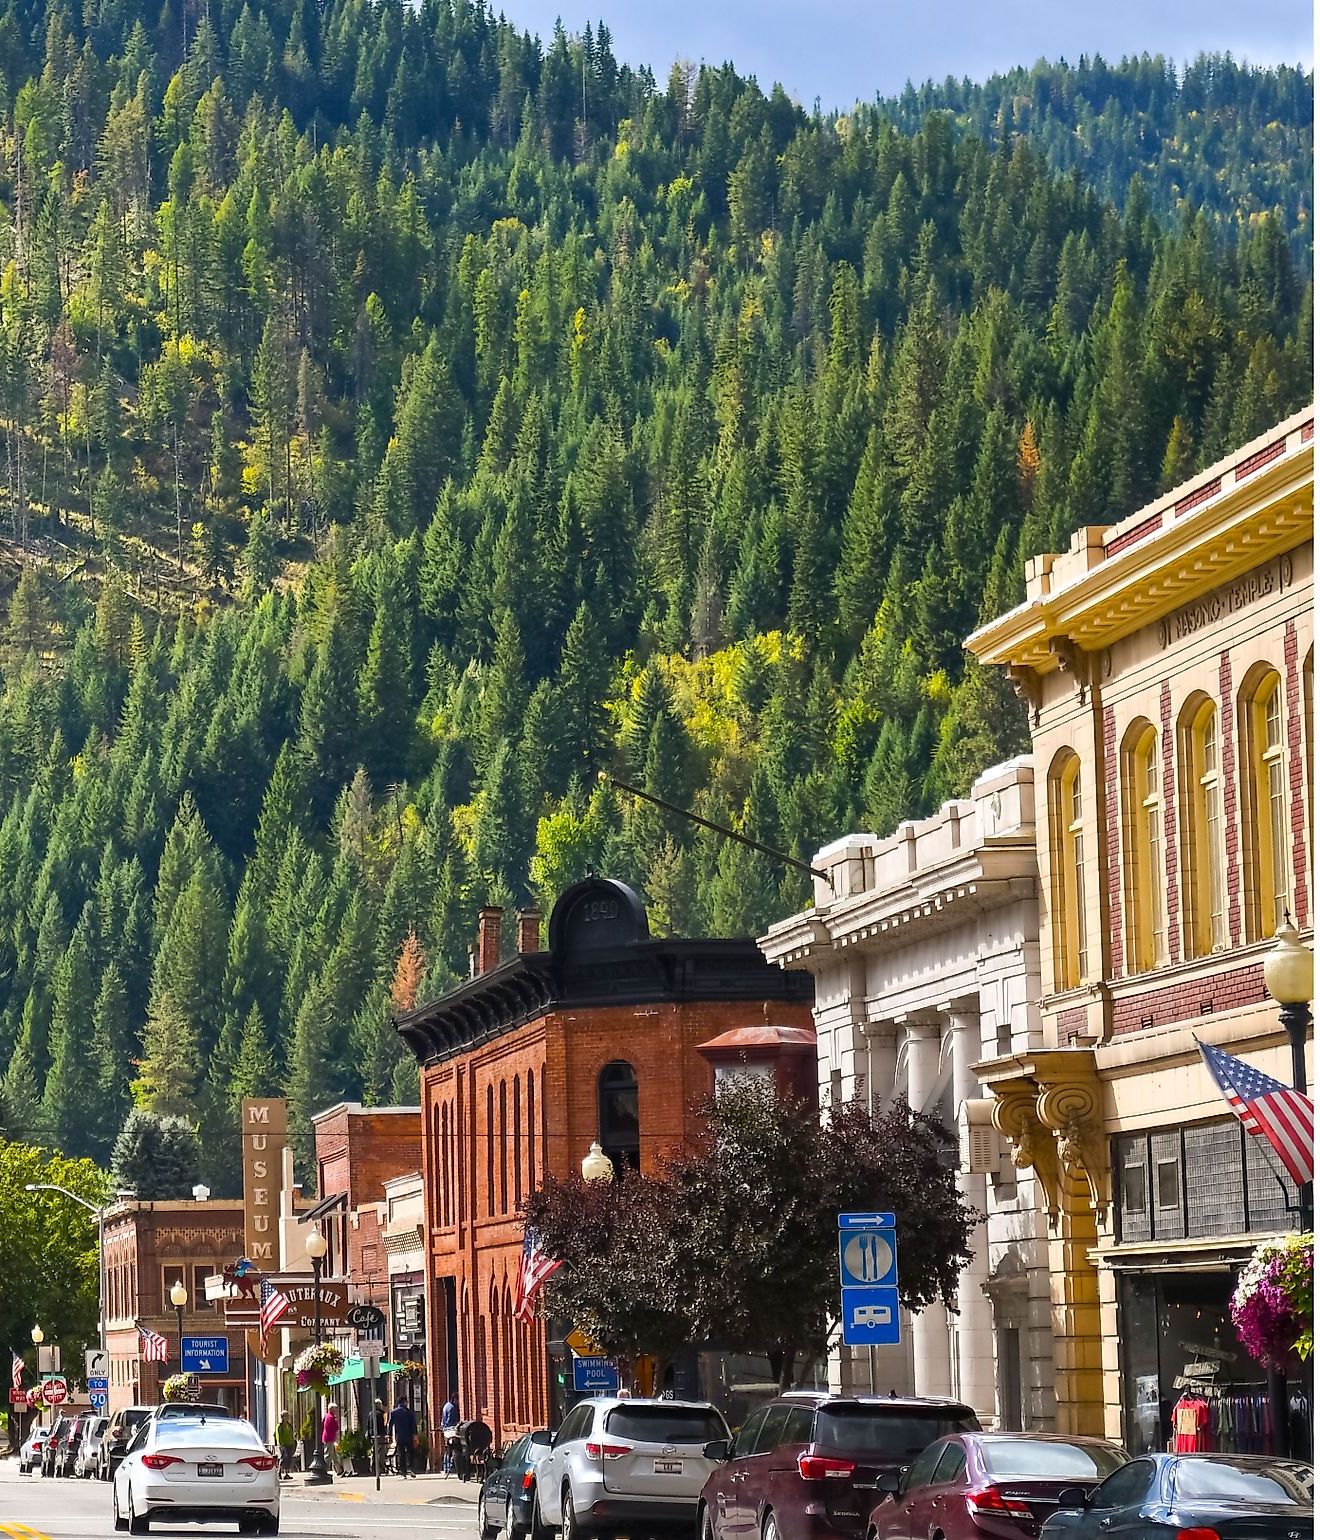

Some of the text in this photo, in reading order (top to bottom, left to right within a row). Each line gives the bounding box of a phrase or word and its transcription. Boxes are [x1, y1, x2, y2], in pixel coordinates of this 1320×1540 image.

[1226, 571, 1273, 612] TEMPLE
[248, 1106, 272, 1260] MUSEUM
[191, 1340, 218, 1348] TOURIST
[184, 1349, 225, 1357] INFORMATION
[586, 1369, 606, 1378] POOL
[90, 1394, 106, 1404] 90
